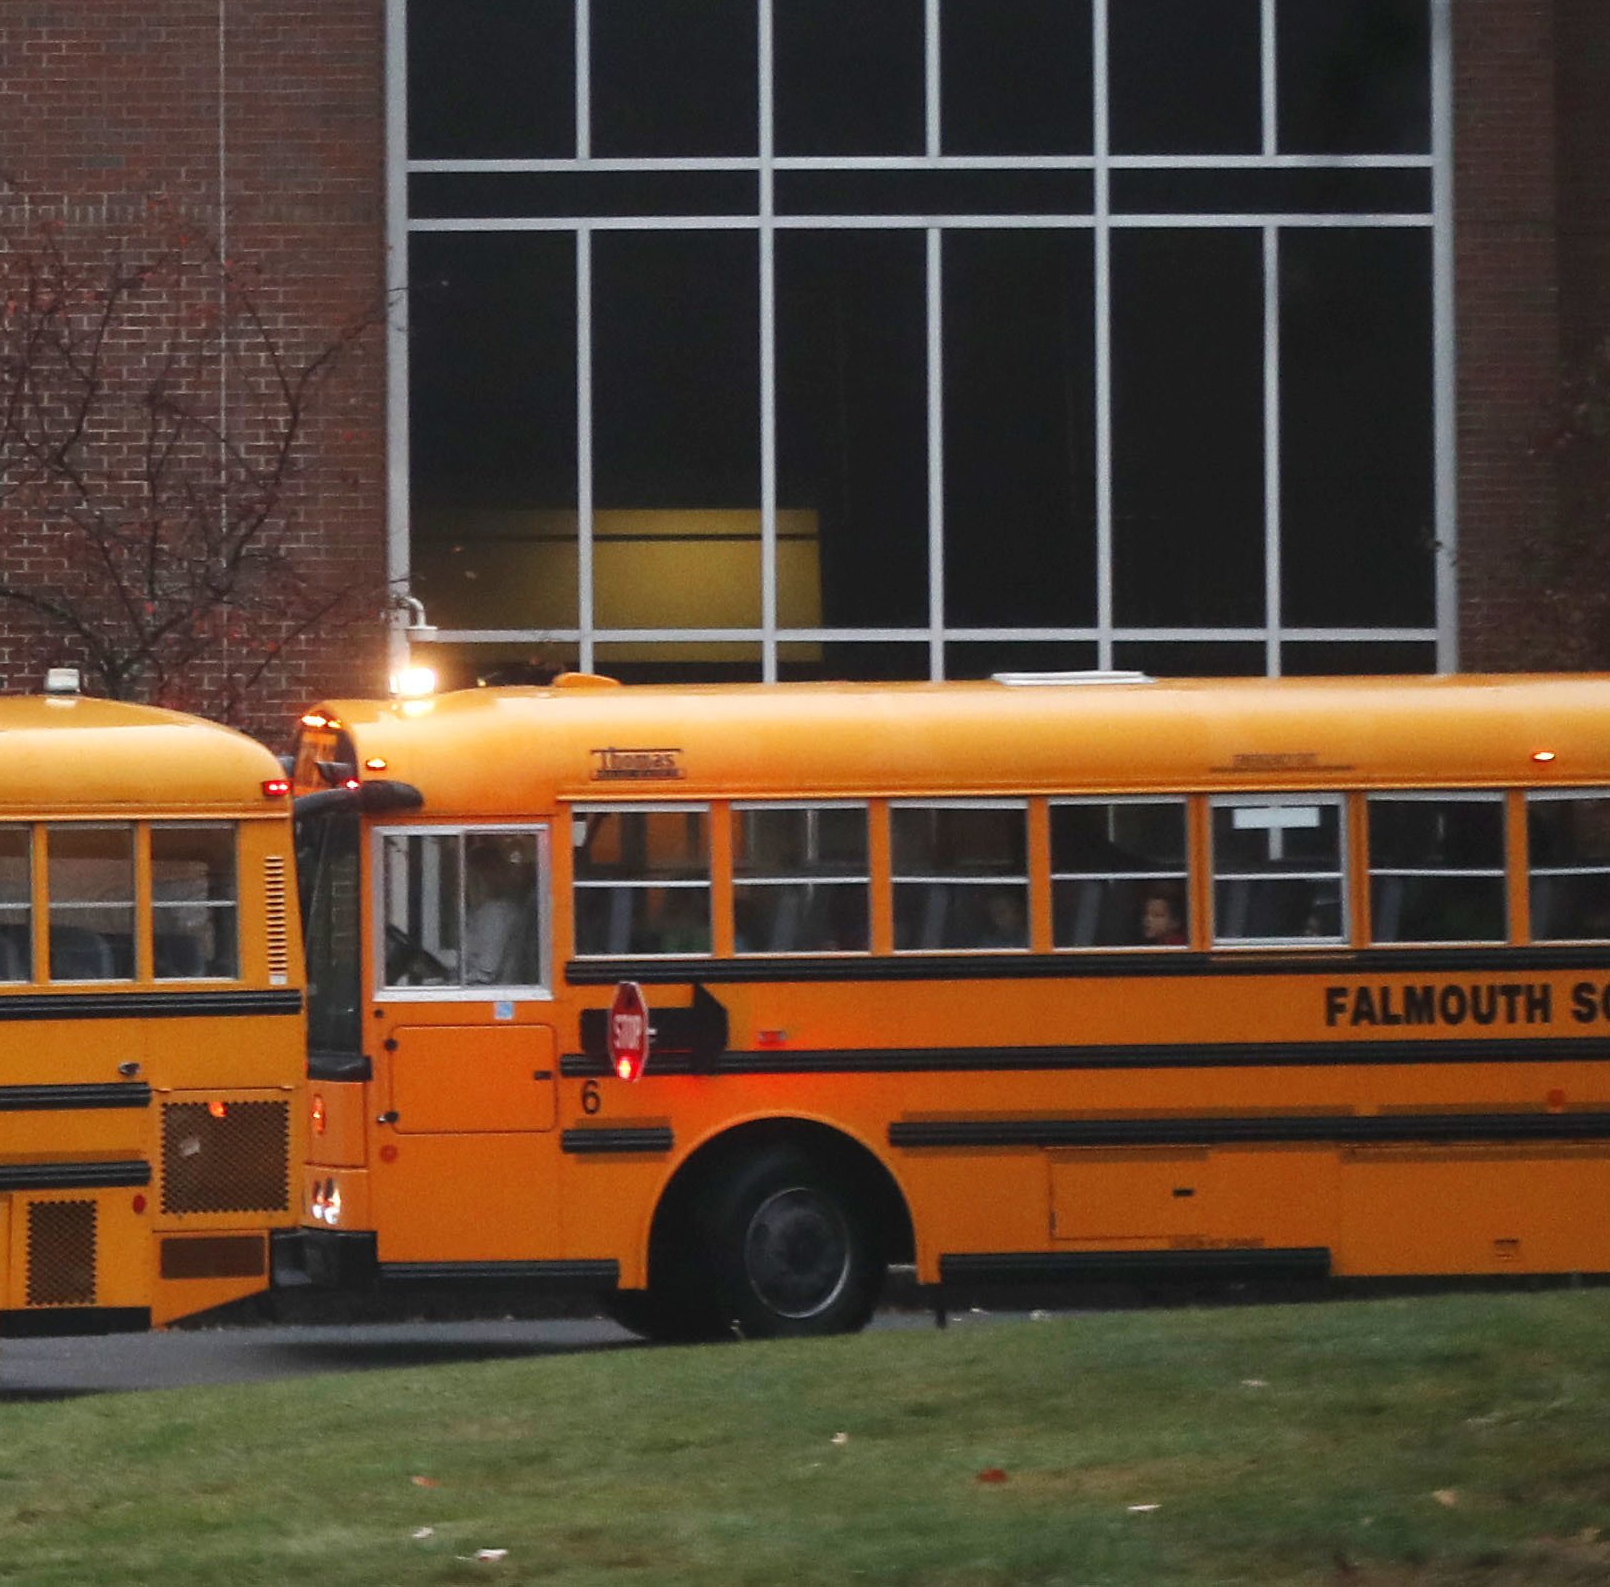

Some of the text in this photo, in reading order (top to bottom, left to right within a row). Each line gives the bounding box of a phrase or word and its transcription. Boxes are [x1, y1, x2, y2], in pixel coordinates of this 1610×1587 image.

[1324, 984, 1552, 1027] FALMOUTH
[613, 1014, 643, 1050] STOP
[582, 1079, 601, 1115] 6
